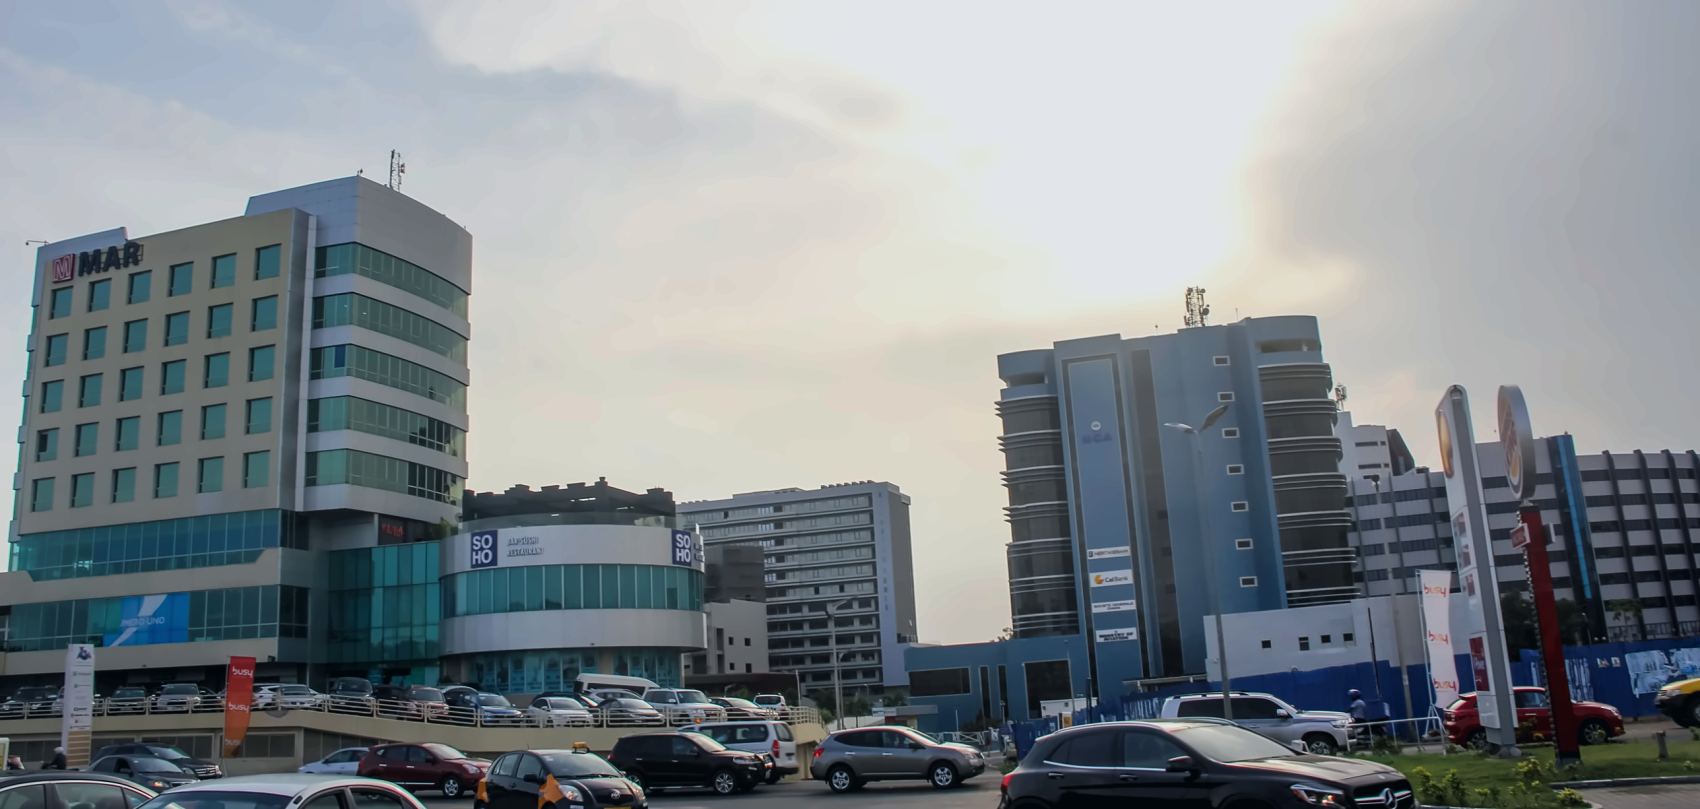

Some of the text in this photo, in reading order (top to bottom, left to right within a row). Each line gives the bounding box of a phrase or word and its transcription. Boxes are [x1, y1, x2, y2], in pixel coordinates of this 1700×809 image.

[79, 241, 140, 277] MAR
[472, 534, 493, 550] SO
[676, 534, 690, 548] SO
[472, 549, 493, 565] HO
[676, 548, 690, 562] HO
[1424, 584, 1447, 597] busy
[232, 665, 254, 678] busy
[1433, 678, 1457, 692] busy
[228, 701, 250, 713] busy
